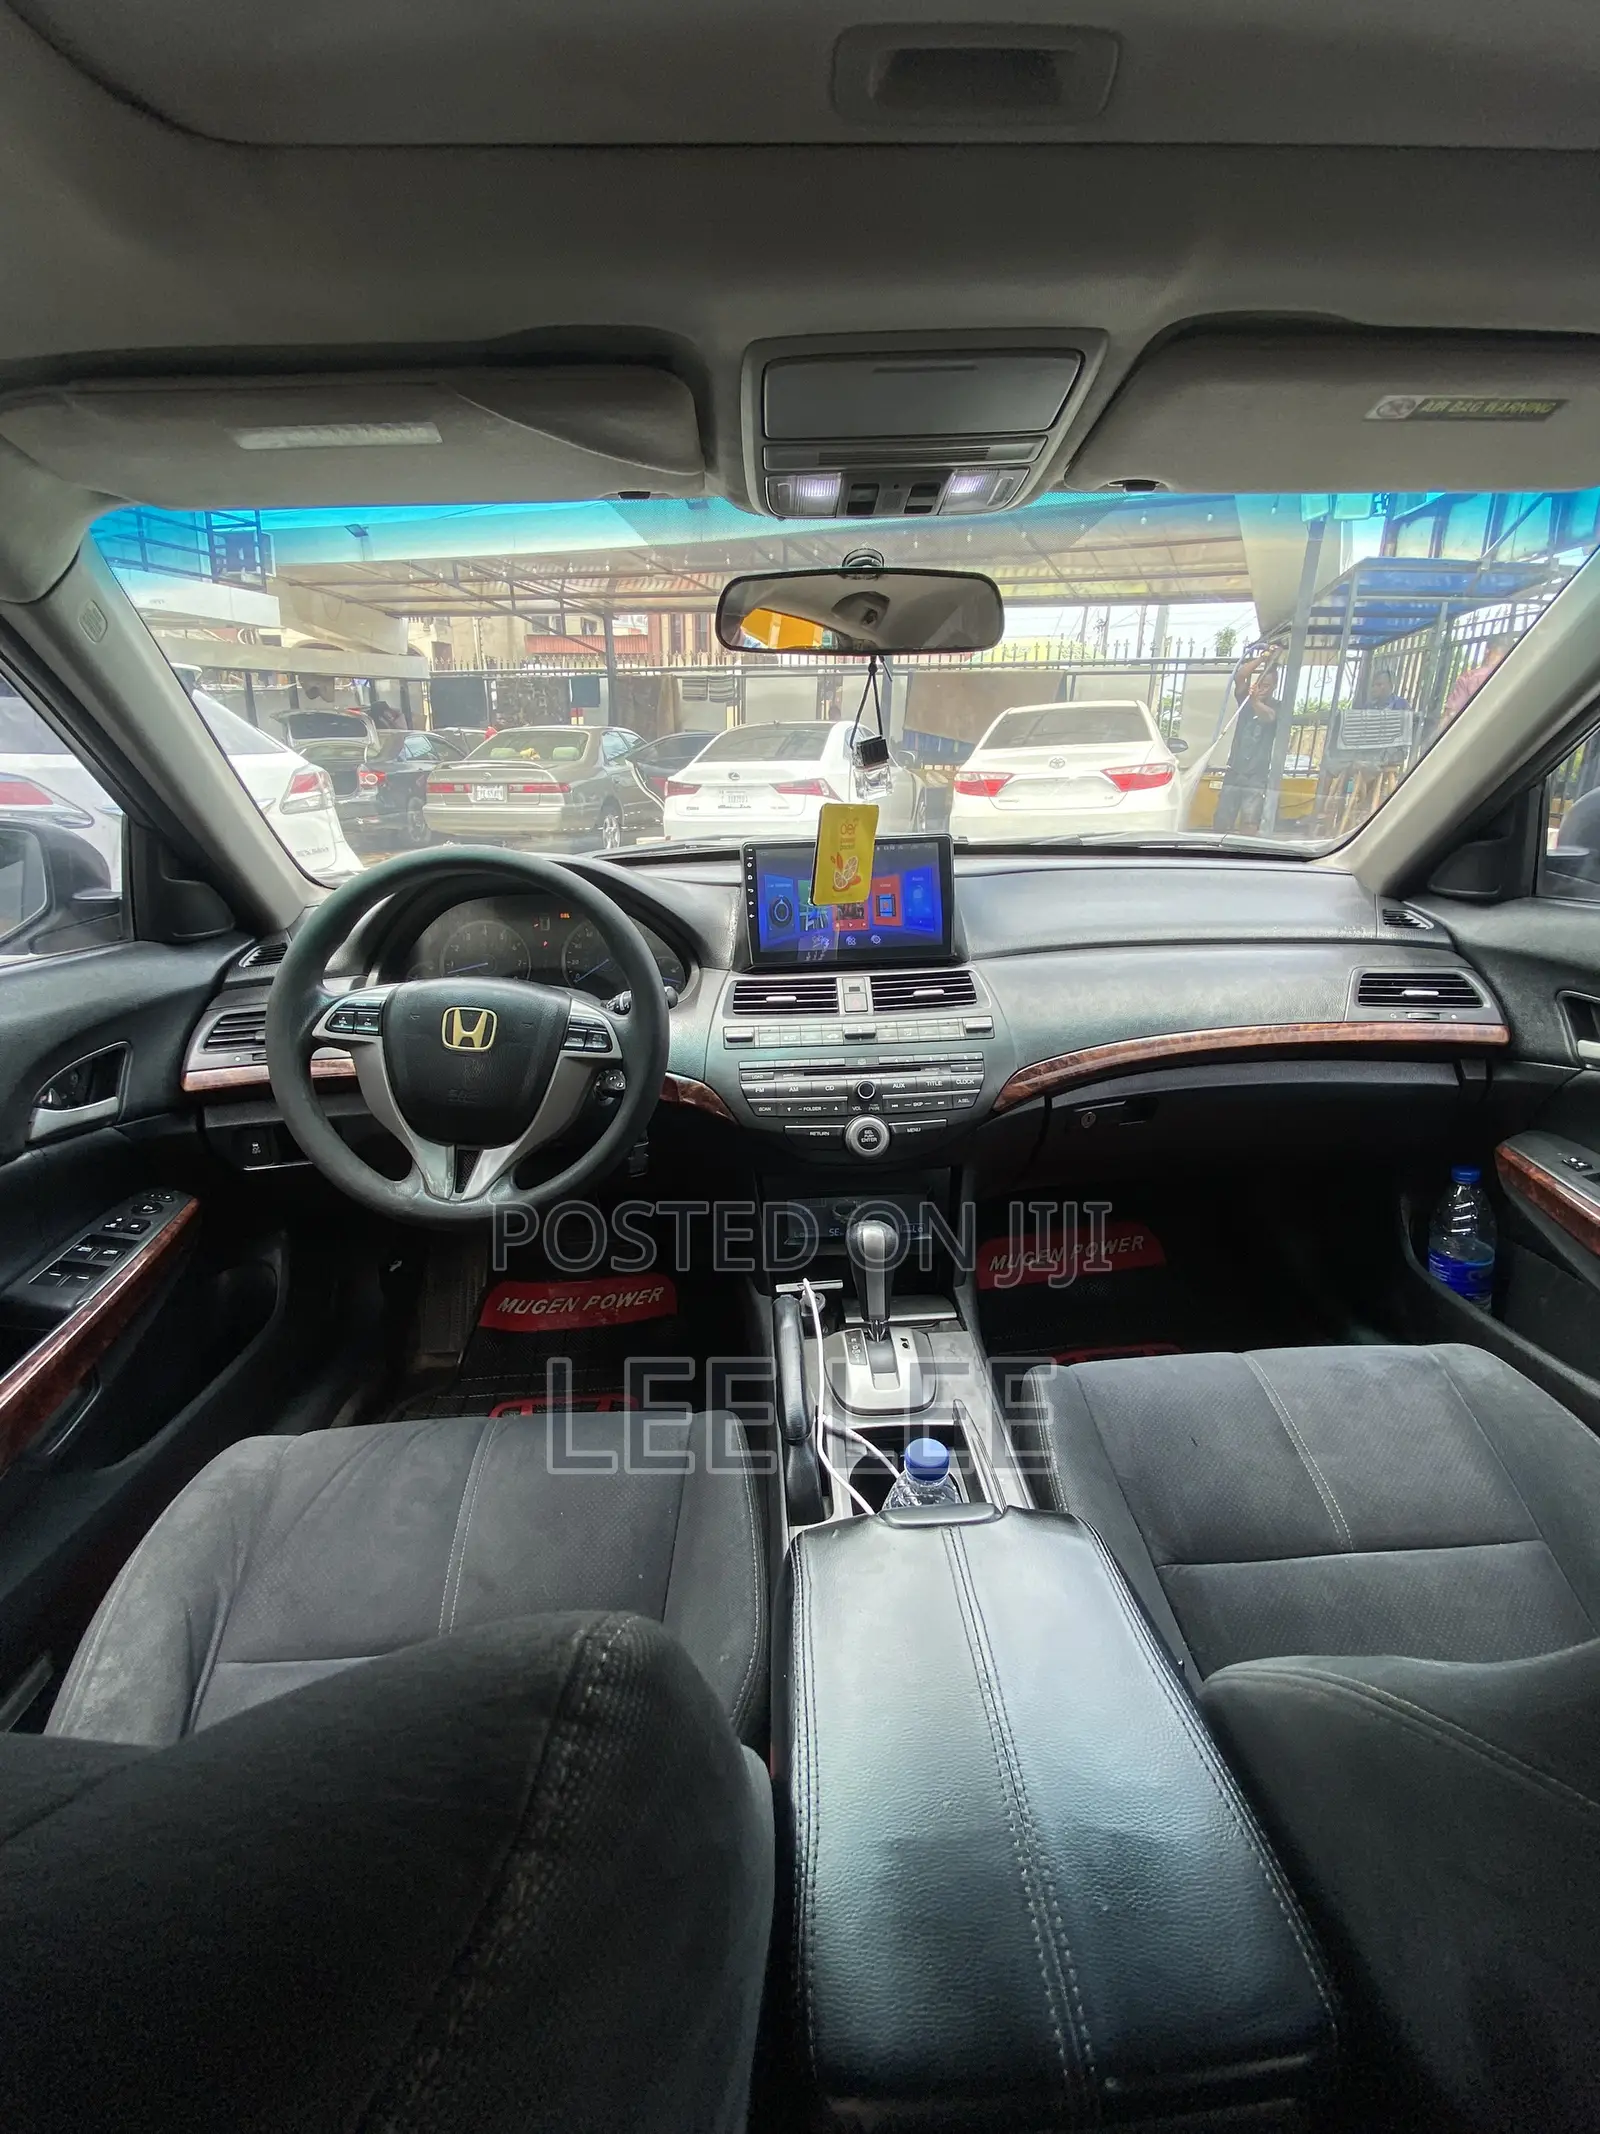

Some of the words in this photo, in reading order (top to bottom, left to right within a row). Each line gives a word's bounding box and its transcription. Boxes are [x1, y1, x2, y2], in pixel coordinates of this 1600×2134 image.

[989, 1248, 1066, 1272] MUGEN
[1070, 1236, 1144, 1260] POWER
[497, 1297, 581, 1315] MUGEN
[582, 1286, 665, 1311] POWER
